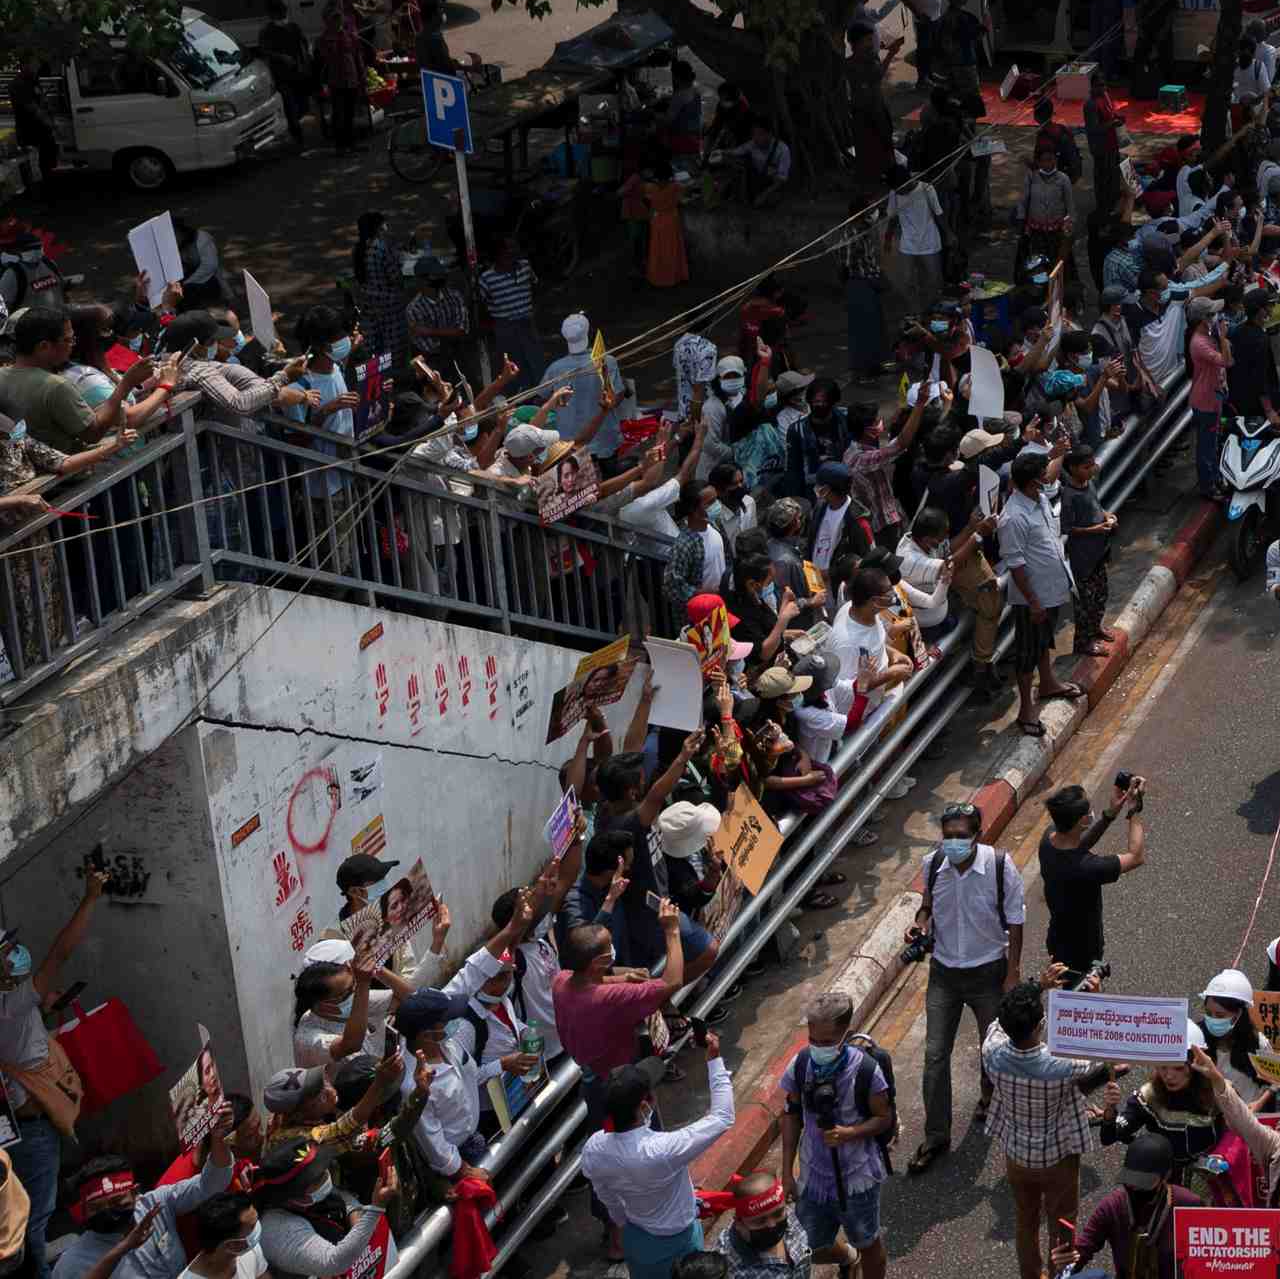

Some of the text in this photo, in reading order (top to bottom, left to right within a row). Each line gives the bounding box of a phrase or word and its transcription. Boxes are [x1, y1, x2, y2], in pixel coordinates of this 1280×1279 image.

[432, 85, 455, 120] P
[1056, 1026, 1184, 1045] ABOLISH THE 2008 CONSTITUTION
[1188, 1227, 1271, 1246] END THE
[1188, 1246, 1272, 1259] DICTATORSHIP
[1205, 1258, 1255, 1272] #Myanmar
